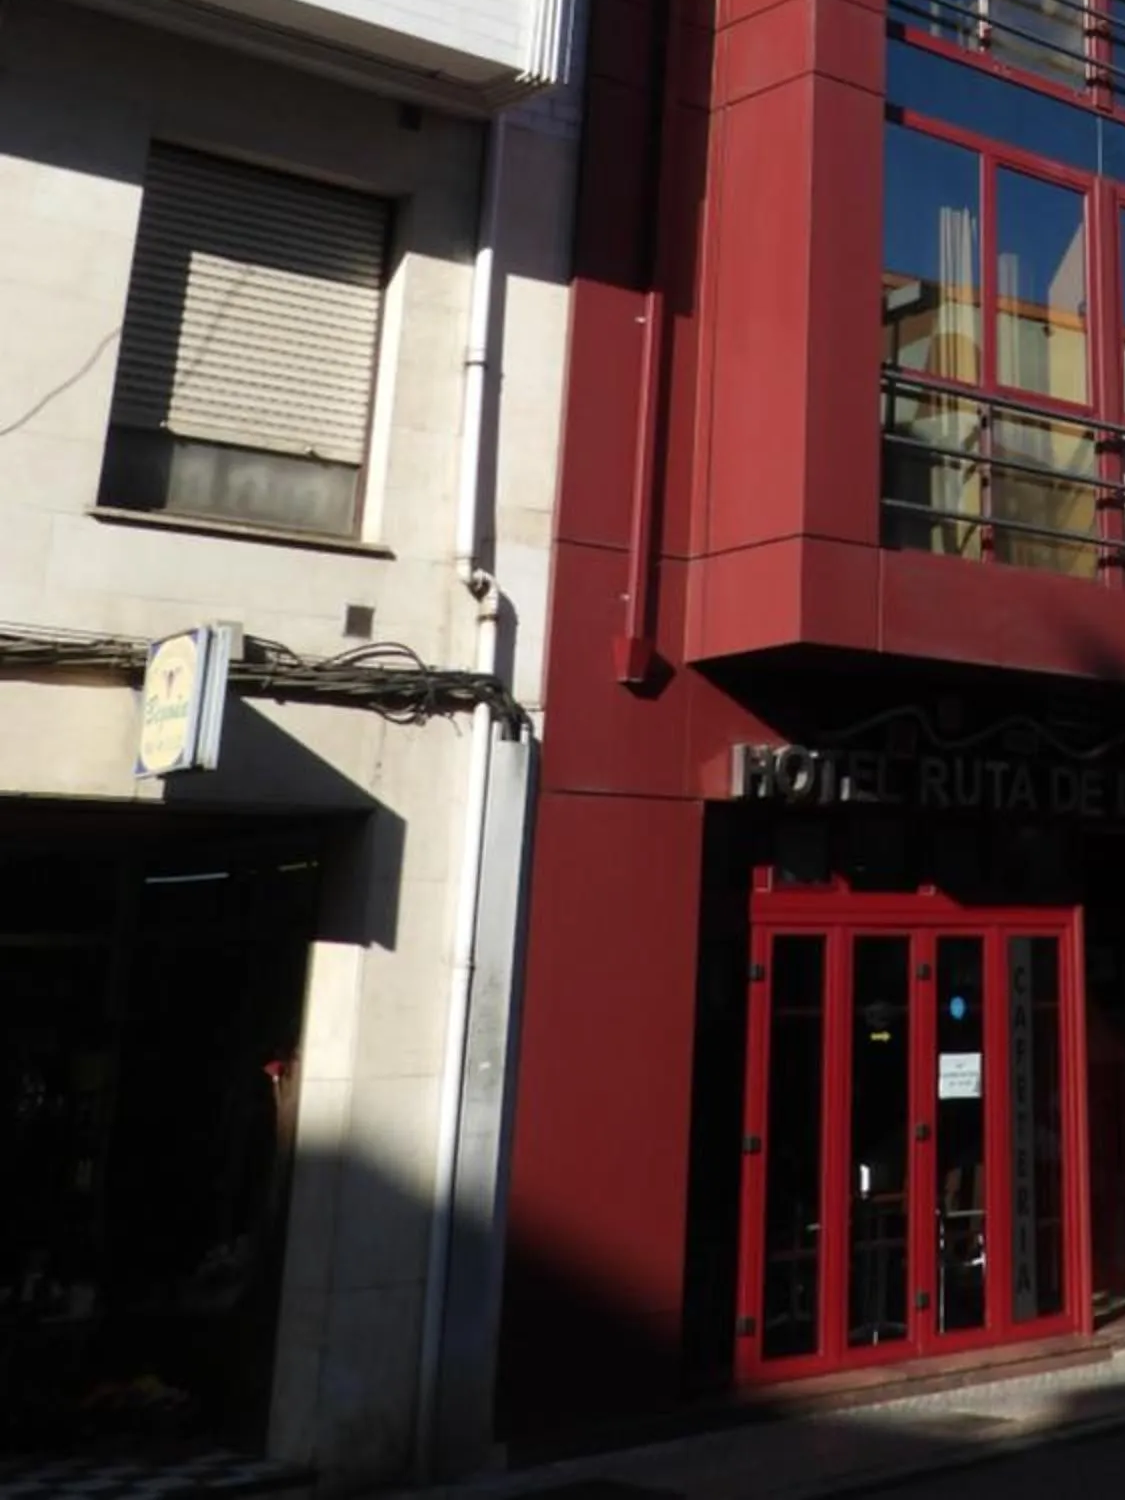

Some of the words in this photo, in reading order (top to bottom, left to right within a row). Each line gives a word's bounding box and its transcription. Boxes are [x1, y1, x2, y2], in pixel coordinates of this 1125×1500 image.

[731, 742, 901, 805] HOTEL
[919, 755, 1037, 811] RUTA
[1049, 766, 1104, 816] DE
[1013, 964, 1032, 1296] CAFETERIA
